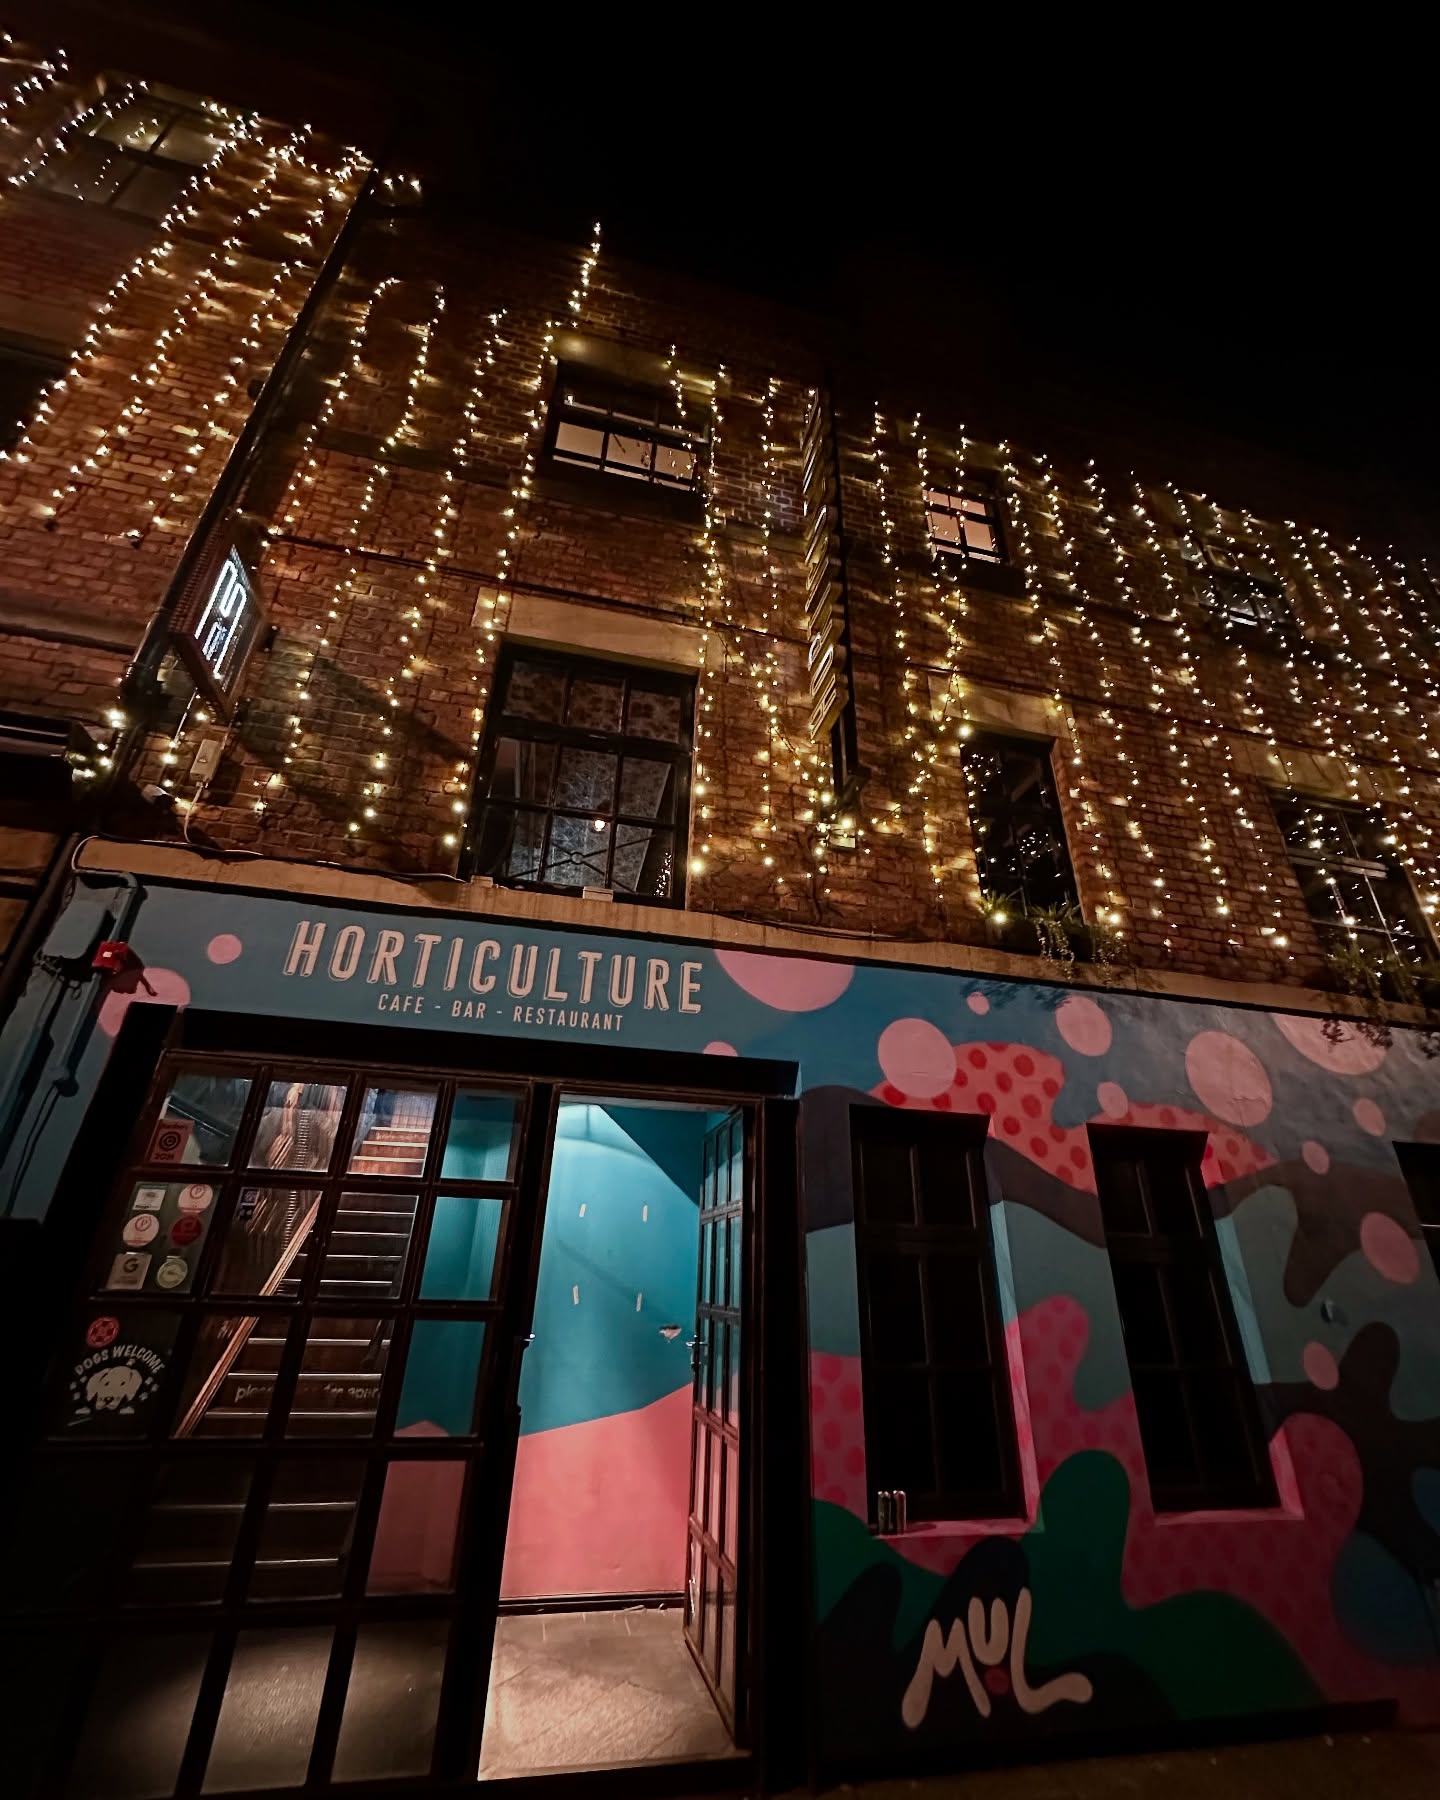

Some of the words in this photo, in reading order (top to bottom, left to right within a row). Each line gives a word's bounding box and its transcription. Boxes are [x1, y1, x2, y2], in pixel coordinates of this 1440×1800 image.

[283, 920, 703, 1014] HORTICULTURE
[378, 993, 425, 1014] CAFE
[451, 1000, 486, 1019] BAR
[513, 1005, 623, 1031] RESTAURANT
[74, 1349, 109, 1376] DOGS
[112, 1344, 165, 1375] WELCOME
